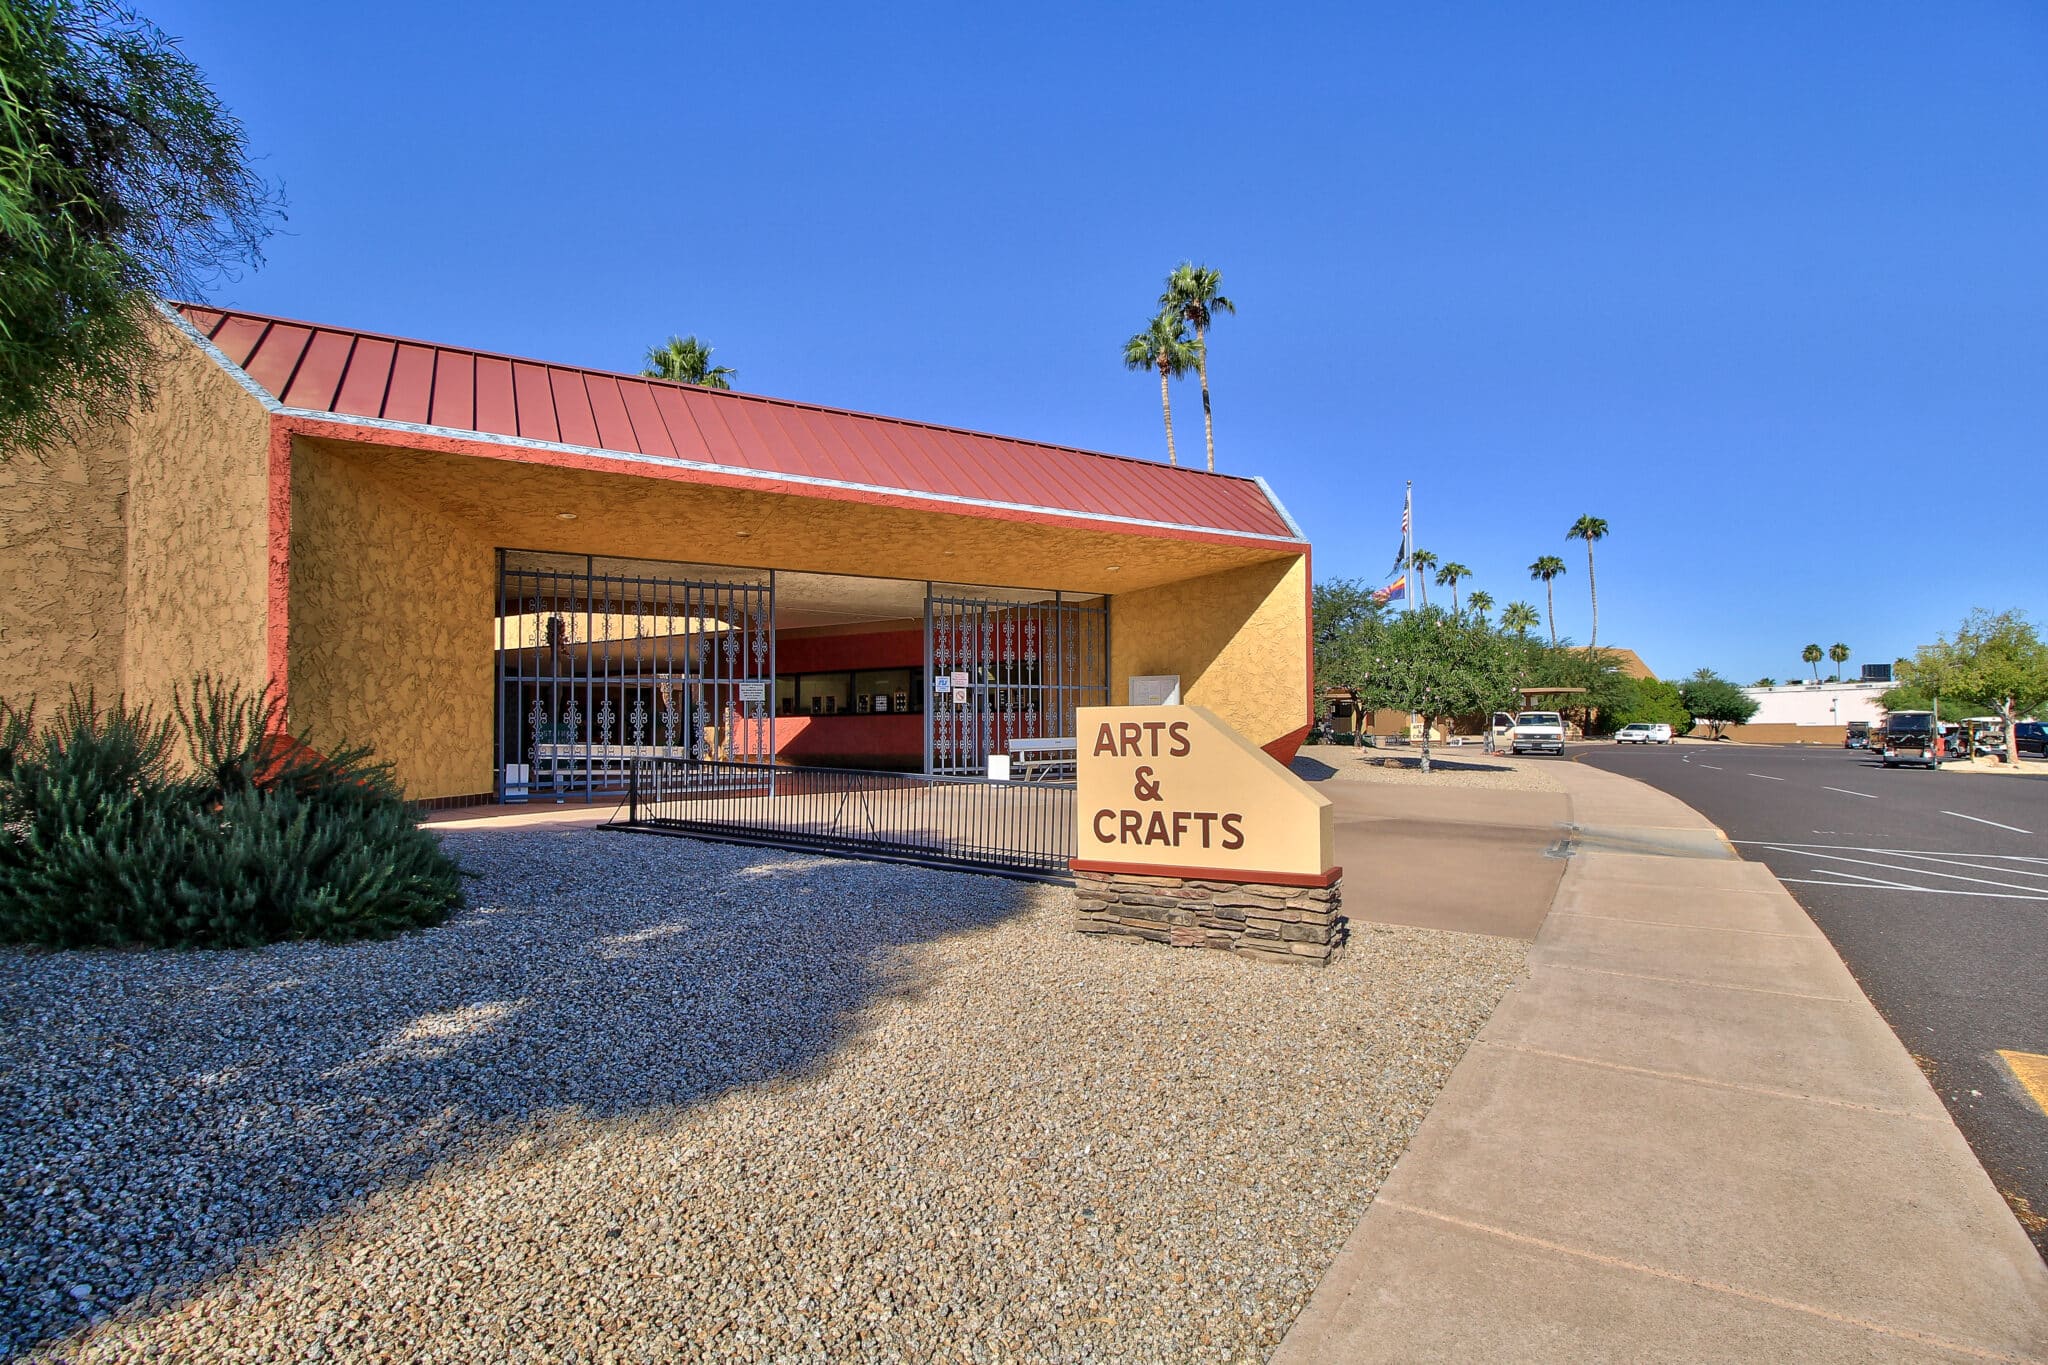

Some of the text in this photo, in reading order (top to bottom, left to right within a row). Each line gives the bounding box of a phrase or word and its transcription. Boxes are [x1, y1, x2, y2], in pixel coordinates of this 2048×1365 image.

[1094, 721, 1191, 757] ARTS
[1134, 765, 1164, 802] &
[1093, 809, 1245, 850] CRAFTS
